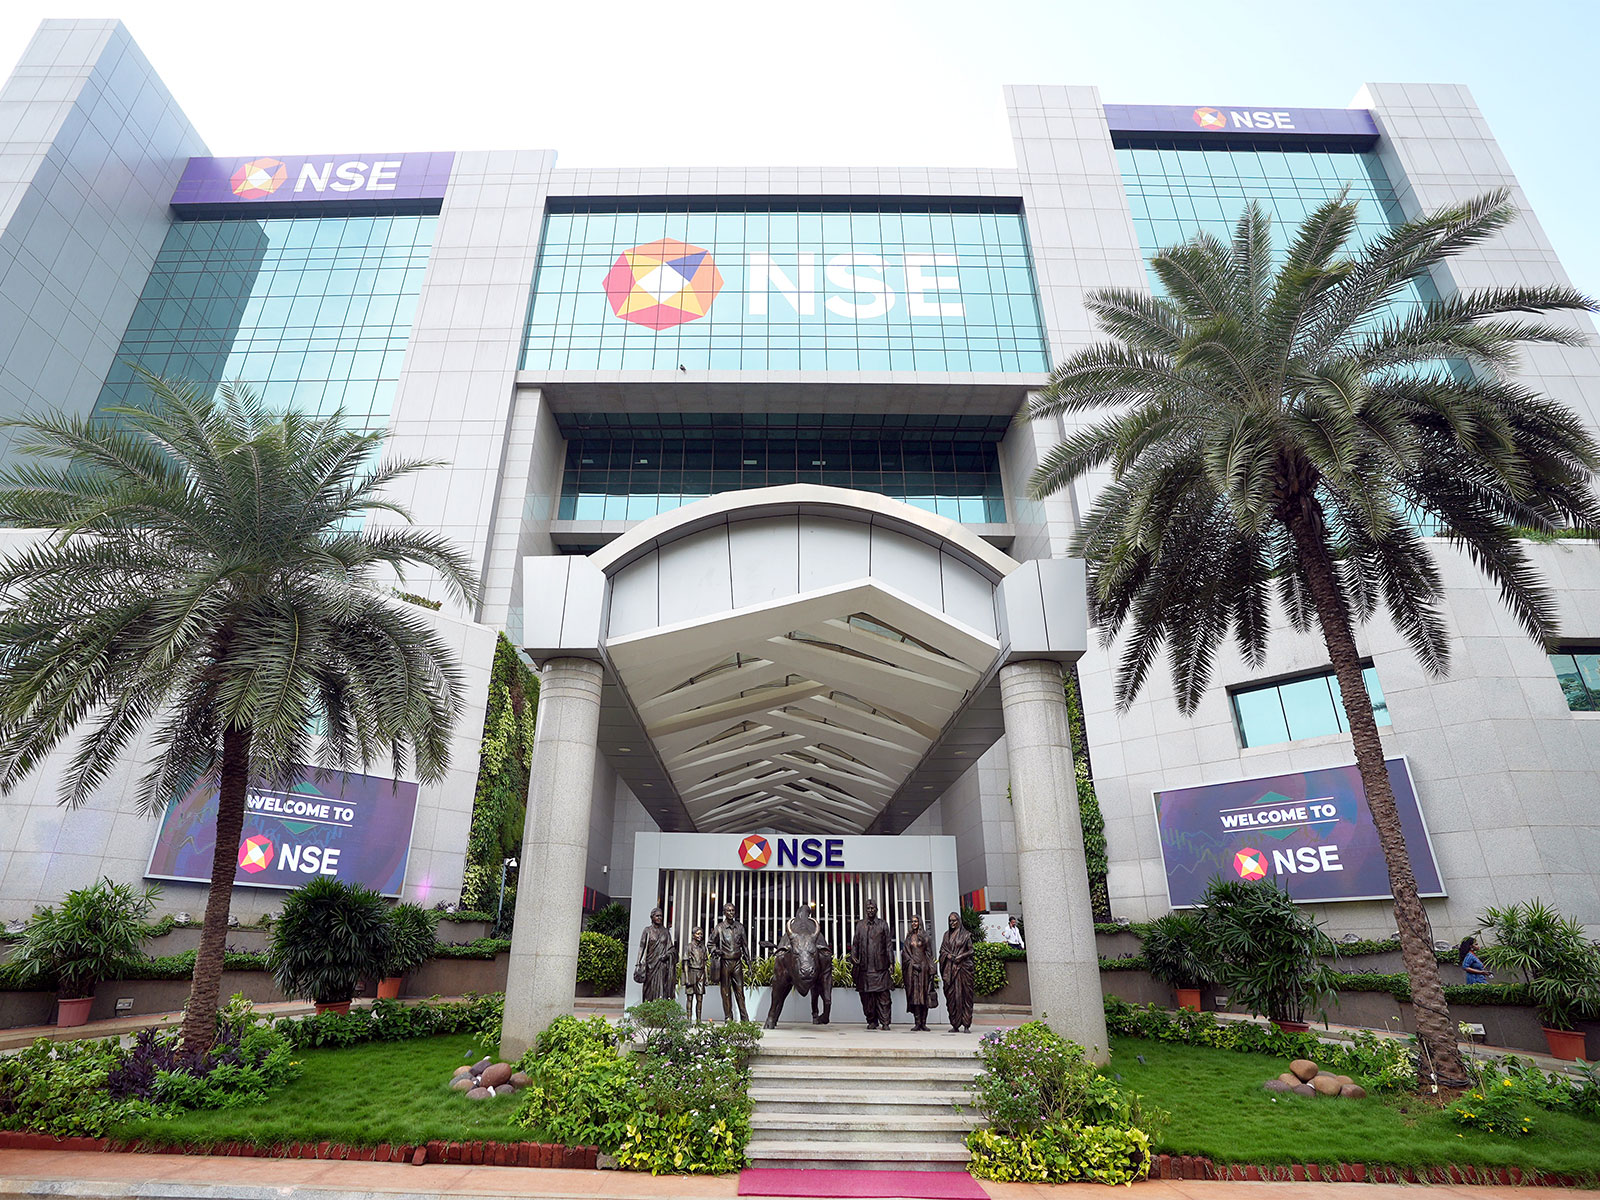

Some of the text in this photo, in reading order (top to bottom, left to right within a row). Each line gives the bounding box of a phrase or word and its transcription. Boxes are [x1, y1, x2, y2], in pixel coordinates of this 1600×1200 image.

[1230, 111, 1295, 130] NSE
[294, 161, 401, 192] NSE
[748, 251, 966, 318] NSE
[247, 795, 354, 822] WELCOME TO
[1220, 803, 1336, 828] WELCOME TO
[277, 843, 341, 875] NSE
[777, 838, 844, 867] NSE
[1272, 845, 1344, 875] NSE
